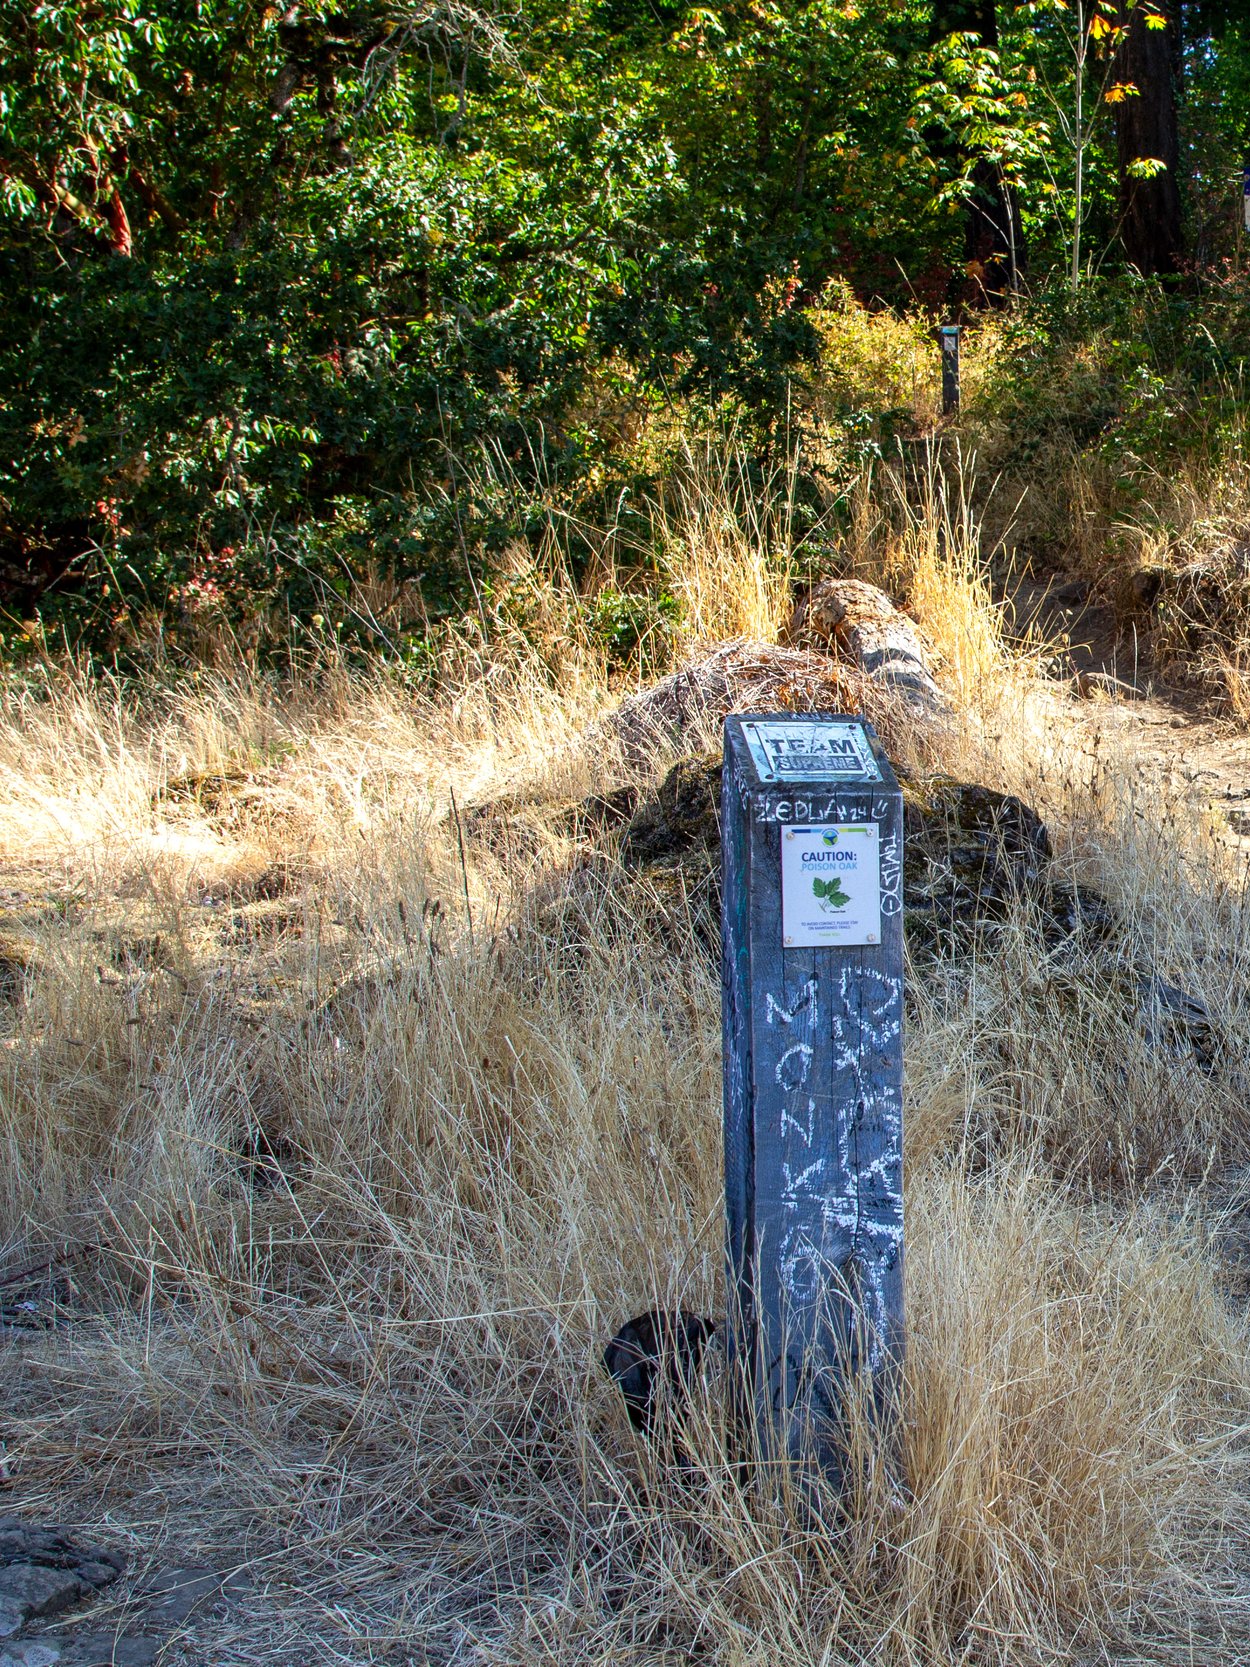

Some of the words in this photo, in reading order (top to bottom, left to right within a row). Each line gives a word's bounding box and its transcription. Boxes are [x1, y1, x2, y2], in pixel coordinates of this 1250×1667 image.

[765, 739, 855, 754] TEAM
[778, 756, 857, 770] SUPREME
[802, 852, 857, 862] CAUTION:
[802, 863, 836, 871] POISON
[838, 862, 857, 870] OAK
